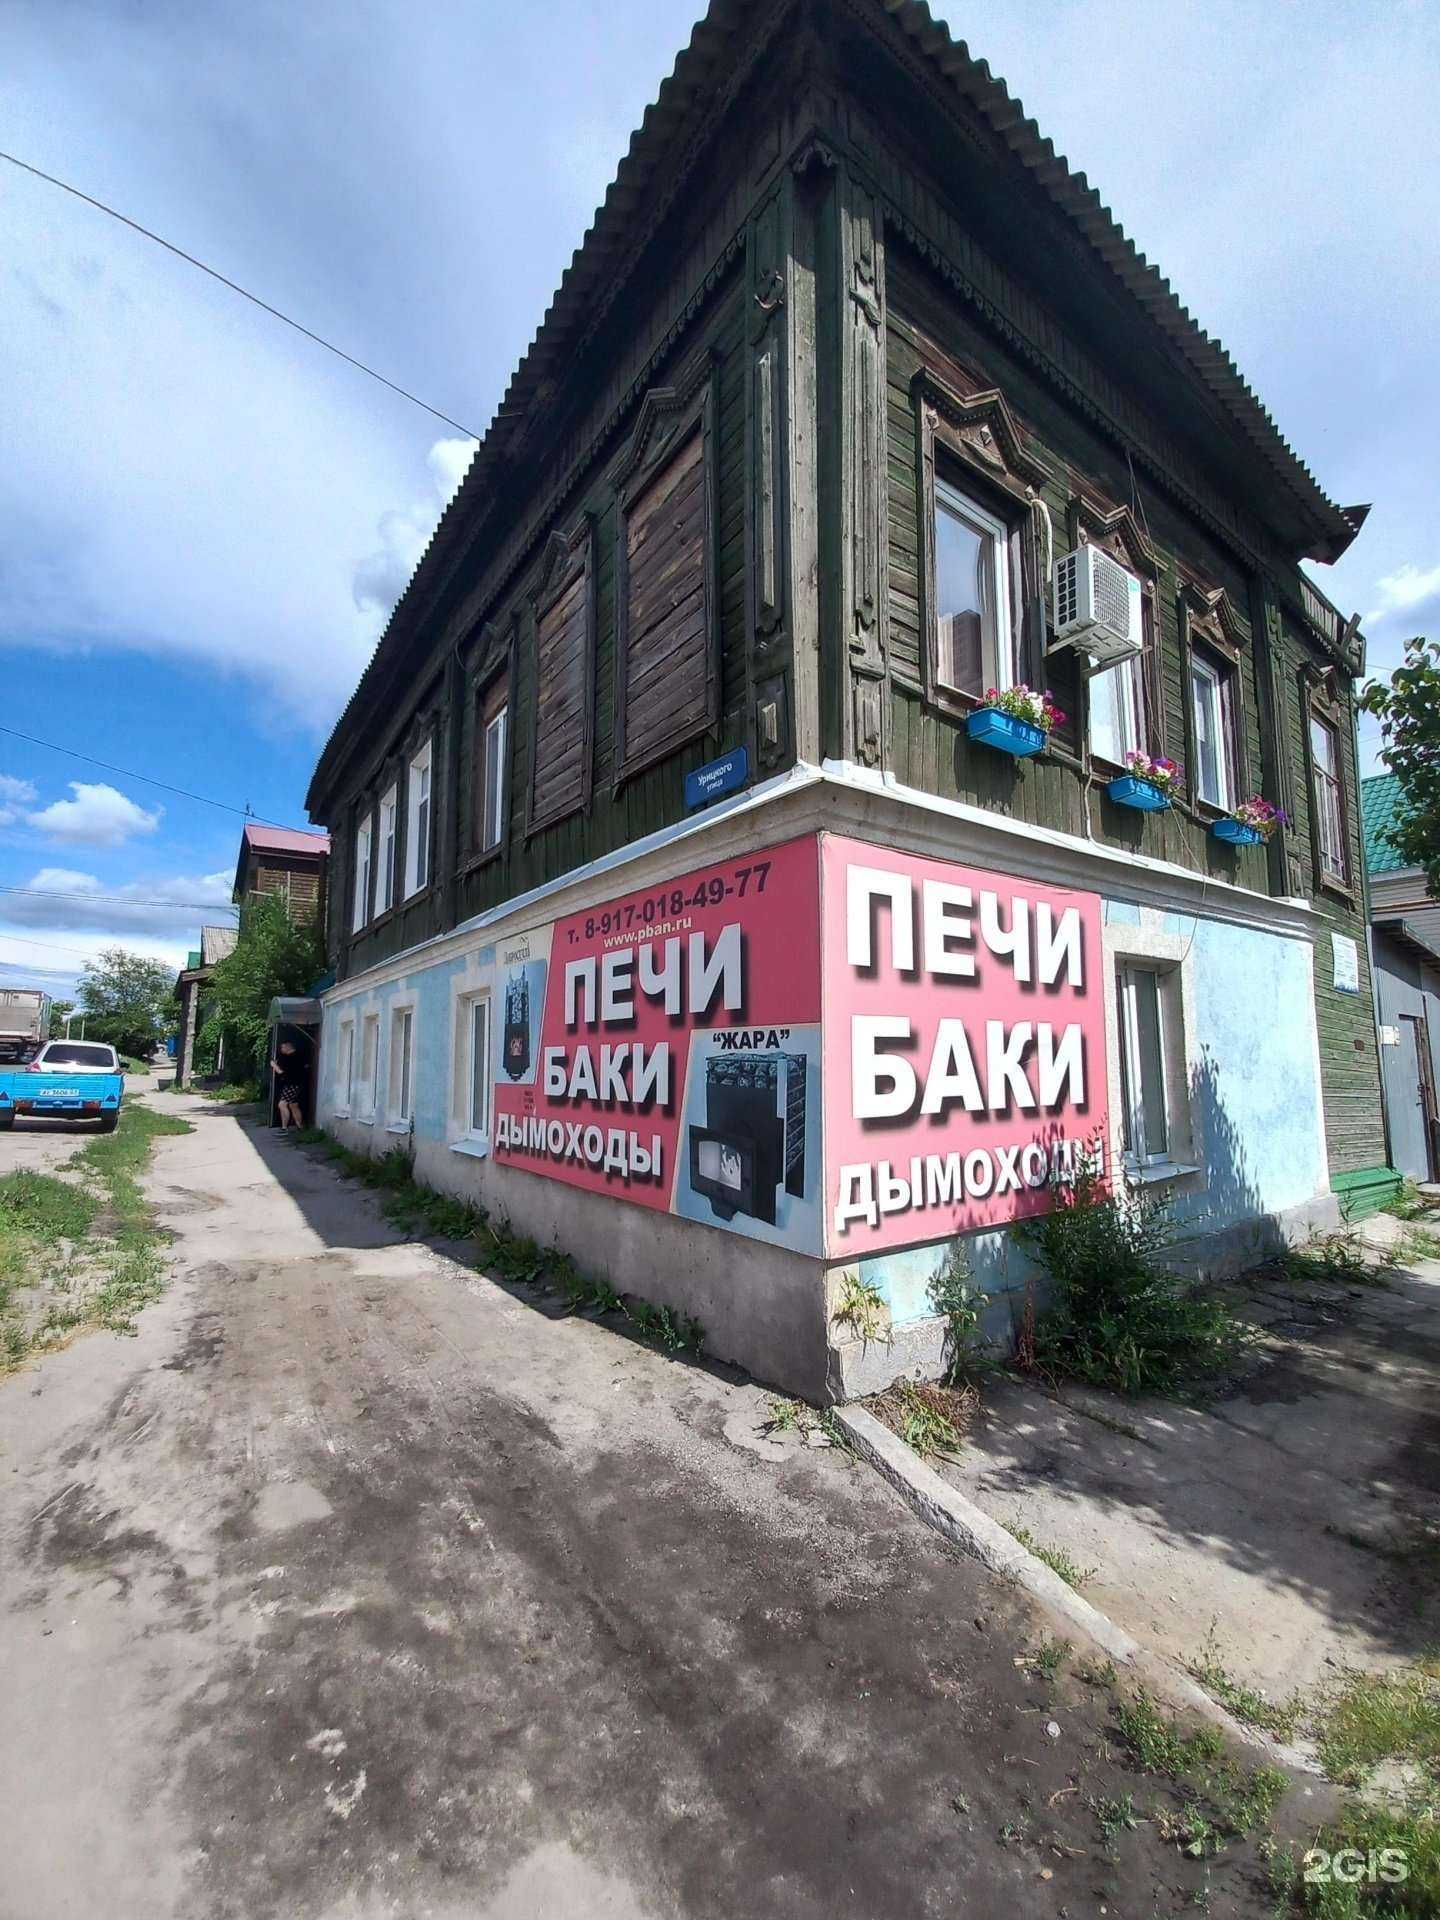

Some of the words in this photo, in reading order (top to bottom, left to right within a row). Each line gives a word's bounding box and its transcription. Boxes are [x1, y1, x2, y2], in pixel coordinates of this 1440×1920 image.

[698, 763, 732, 786] Урицкого
[567, 930, 579, 944] т.
[585, 861, 772, 939] 8-917-018-49-77
[603, 916, 692, 948] www.pban.ru
[846, 863, 1083, 988] ПЕЧИ
[564, 923, 743, 1026] ПЕЧИ
[543, 1041, 670, 1106] БАКИ
[851, 1014, 1085, 1120] БАКИ
[495, 1112, 662, 1178] ДЫМОХОДЫ
